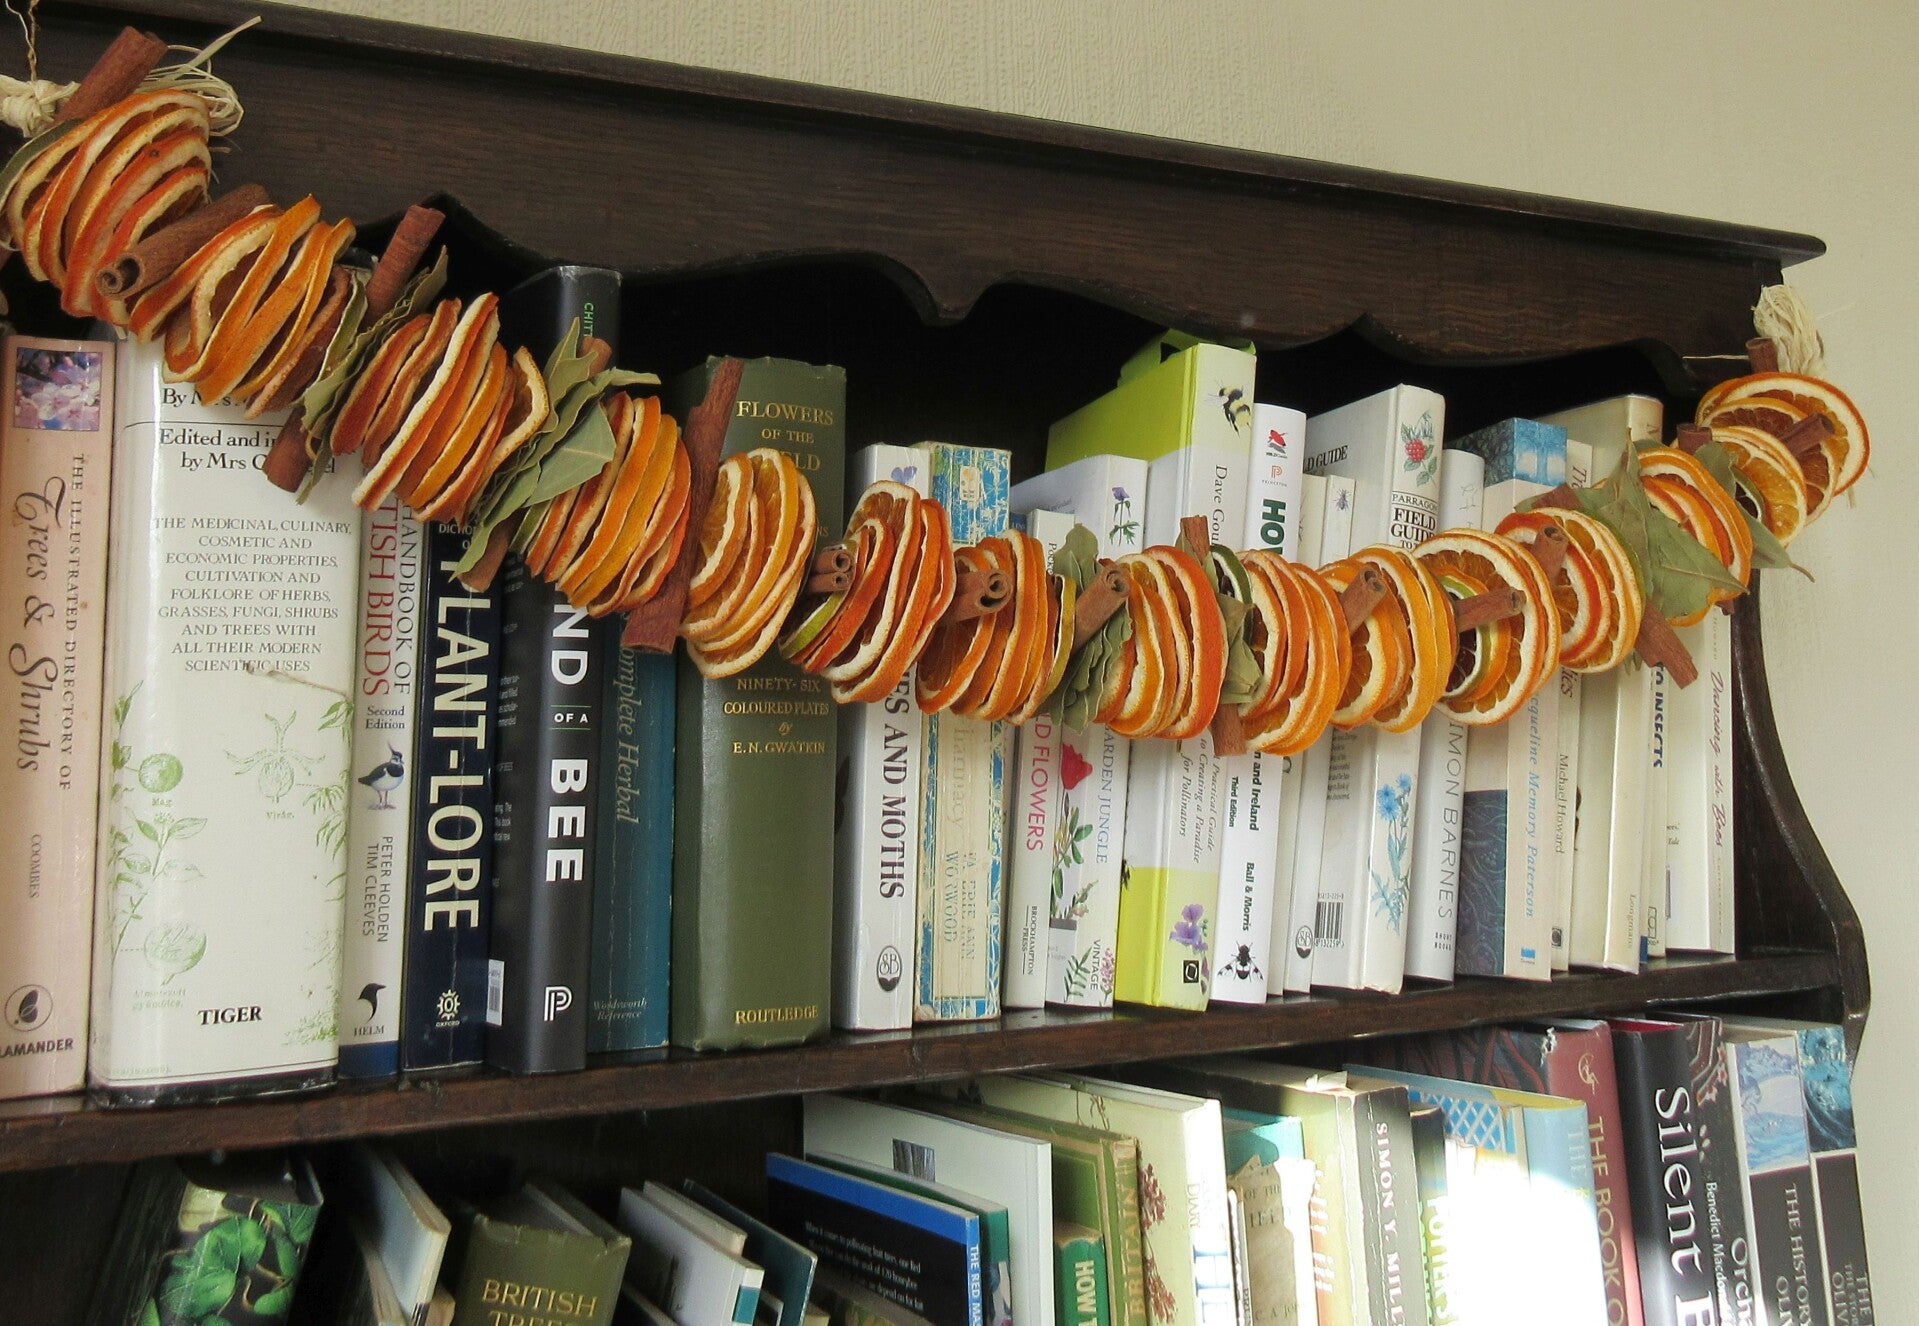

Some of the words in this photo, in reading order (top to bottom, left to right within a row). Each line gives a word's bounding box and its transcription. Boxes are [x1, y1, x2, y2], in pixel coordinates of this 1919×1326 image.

[584, 303, 594, 337] CHITT
[162, 388, 188, 409] By
[736, 400, 834, 426] FLOWERS
[160, 428, 222, 447] Edited
[226, 430, 260, 448] and
[761, 428, 782, 440] OF
[785, 430, 815, 444] THE
[70, 454, 84, 491] THE
[181, 455, 203, 472] by
[206, 456, 247, 471] Mrs
[1316, 445, 1349, 469] GUIDE
[1213, 465, 1228, 504] Dave
[14, 476, 66, 581] Trees
[154, 517, 186, 530] THE
[191, 517, 279, 532] MEDICINAL,
[1393, 507, 1437, 532] FIELD
[165, 553, 248, 566] ECONOMIC
[252, 554, 339, 568] PROPERTIES,
[198, 536, 276, 549] COSMETIC
[278, 537, 312, 549] AND
[368, 499, 399, 583] TISH
[1046, 542, 1058, 575] Pocke
[64, 498, 83, 630] ILLUSTRATED
[185, 570, 283, 583] CULTIVATION
[287, 571, 321, 584] AND
[23, 594, 55, 630] &
[158, 606, 229, 619] GRASSES,
[233, 606, 282, 620] FUNGI,
[284, 607, 339, 619] SHRUBS
[170, 588, 254, 601] FOLKLORE
[259, 589, 280, 601] OF
[281, 589, 332, 602] HERBS,
[171, 642, 203, 654] ALL
[206, 642, 254, 654] THEIR
[258, 642, 322, 654] MODERN
[181, 624, 217, 636] AND
[222, 624, 271, 636] TREES
[276, 624, 316, 636] WITH
[362, 590, 395, 696] BIRDS
[551, 604, 590, 685] ND
[275, 660, 311, 673] USES
[393, 661, 412, 695] OF
[8, 643, 59, 772] Shrubs
[59, 641, 77, 758] DIRECTORY
[367, 706, 405, 717] Second
[613, 648, 642, 736] omplete
[723, 701, 794, 715] COLOURED
[794, 701, 830, 716] PLATES
[365, 718, 406, 730] Edition
[554, 713, 574, 724] OF
[579, 713, 588, 723] A
[1526, 697, 1541, 766] cqueline
[1653, 690, 1665, 769] INSECTS
[1707, 670, 1726, 754] Dancing
[424, 561, 492, 932] LANT-LORE
[733, 742, 747, 754] E.
[748, 742, 763, 754] N.
[765, 741, 826, 754] GWATKIN
[882, 723, 909, 786] AND
[1446, 724, 1465, 797] IMON
[57, 764, 72, 790] OF
[615, 743, 641, 824] Herbal
[1229, 776, 1239, 798] Third
[1252, 761, 1262, 786] and
[1556, 754, 1569, 800] Michael
[1026, 749, 1051, 852] FLOWERS
[1179, 775, 1192, 838] Pollinators
[1227, 799, 1237, 828] Edition
[1249, 788, 1261, 831] Ireland
[1524, 771, 1541, 843] Memory
[545, 759, 588, 882] BEE
[1096, 796, 1115, 865] JUNGLE
[1206, 816, 1218, 852] Guide
[1555, 802, 1568, 854] Howard
[1709, 801, 1727, 848] Bees
[366, 843, 380, 869] TIM
[380, 836, 394, 878] PETER
[878, 795, 907, 899] MOTHS
[1438, 808, 1459, 919] BARNES
[1245, 862, 1254, 883] Ball
[1524, 846, 1539, 918] Paterson
[362, 874, 378, 937] CLEEVES
[377, 883, 391, 943] HOLDEN
[1243, 895, 1253, 931] Morris
[1089, 939, 1101, 990] VINTAGE
[198, 1005, 262, 1026] TIGER
[353, 1024, 386, 1037] HELM
[734, 1004, 820, 1025] ROUTLEDGE
[1376, 1122, 1395, 1209] SIMON
[1588, 1115, 1609, 1177] THE
[1655, 1086, 1703, 1276] Silent
[1705, 1182, 1721, 1240] Benedict
[1784, 1182, 1802, 1232] THE
[1384, 1219, 1399, 1242] Y.
[1595, 1187, 1621, 1288] BOOK
[968, 1244, 980, 1270] THE
[481, 1278, 599, 1319] BRITISH
[970, 1273, 982, 1298] RED
[1074, 1260, 1097, 1312] HOW
[1832, 1271, 1850, 1326] OLIV
[1856, 1271, 1873, 1316] THE
[1607, 1299, 1625, 1326] O
